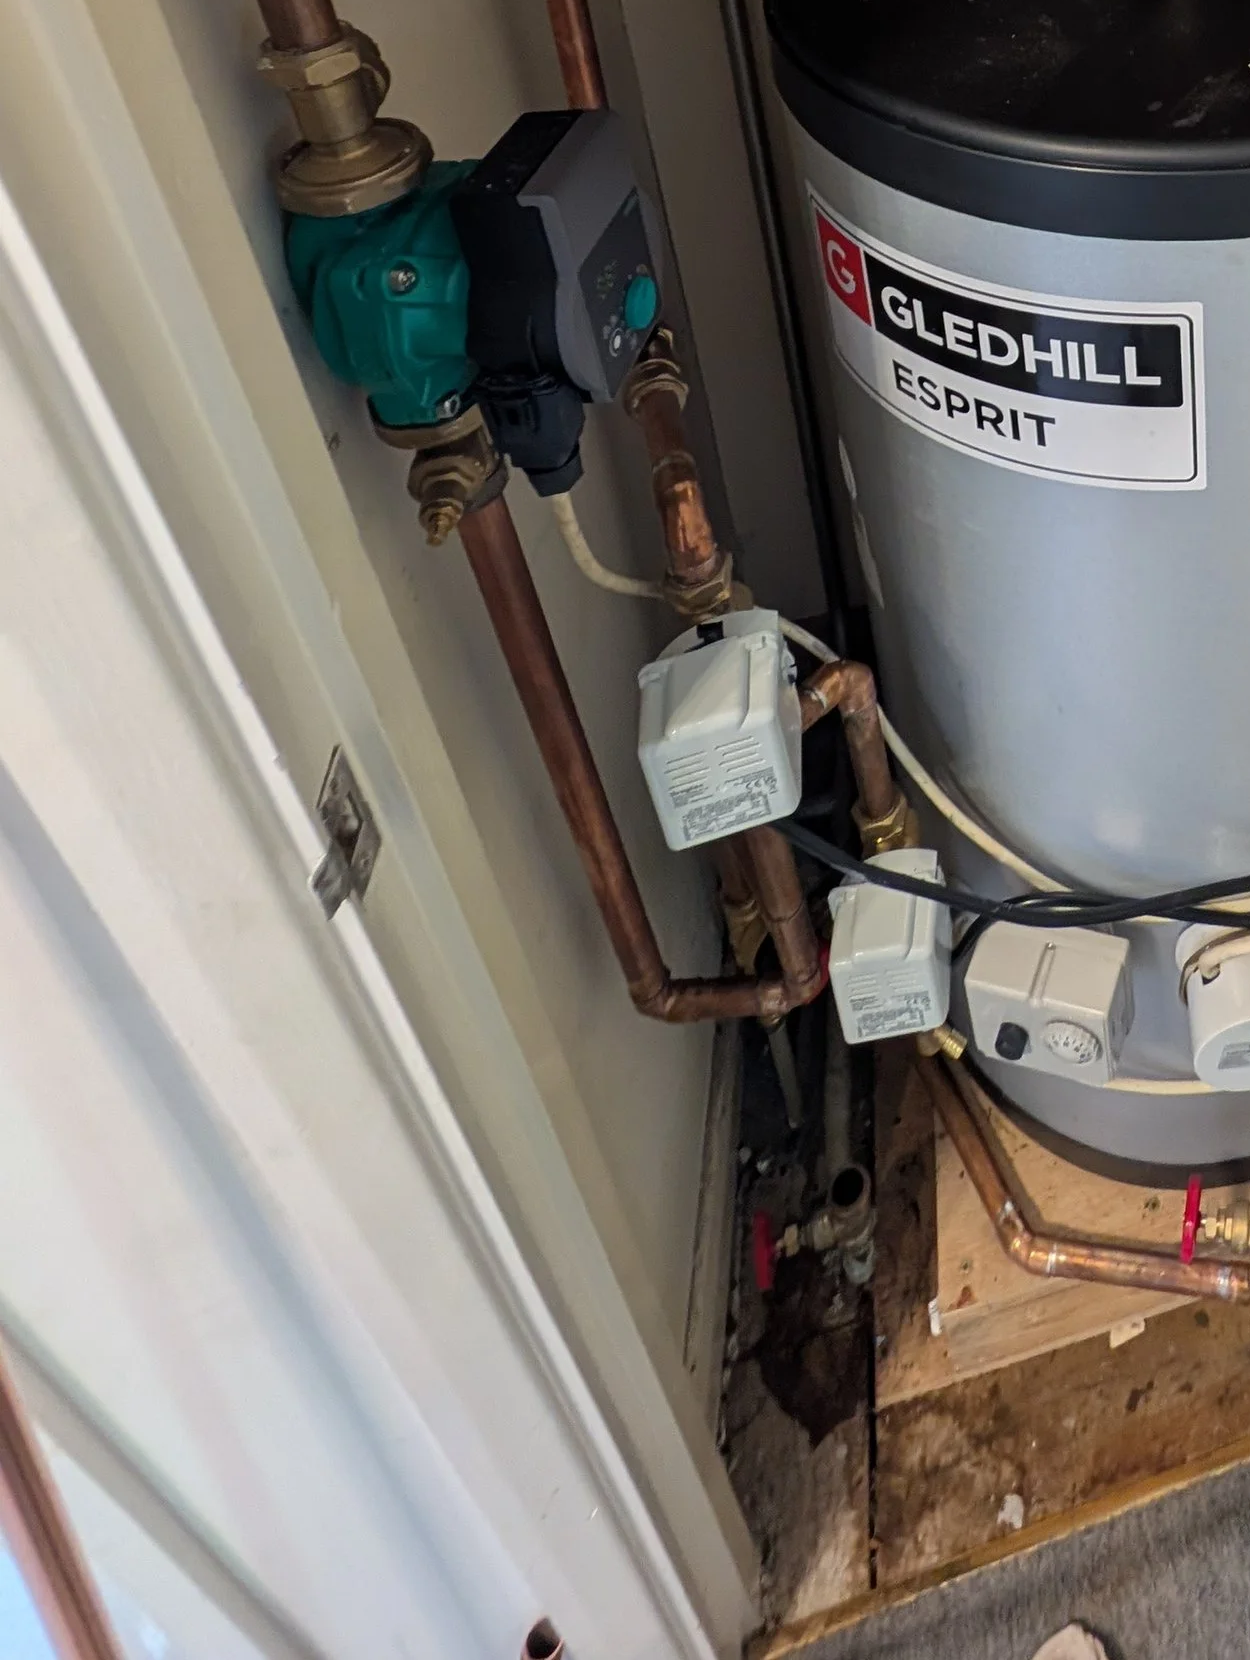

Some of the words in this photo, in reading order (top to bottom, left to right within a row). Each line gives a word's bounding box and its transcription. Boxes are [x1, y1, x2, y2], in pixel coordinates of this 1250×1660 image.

[826, 239, 856, 294] G
[880, 286, 1162, 387] GLEDHILL
[892, 358, 1056, 447] ESPRIT
